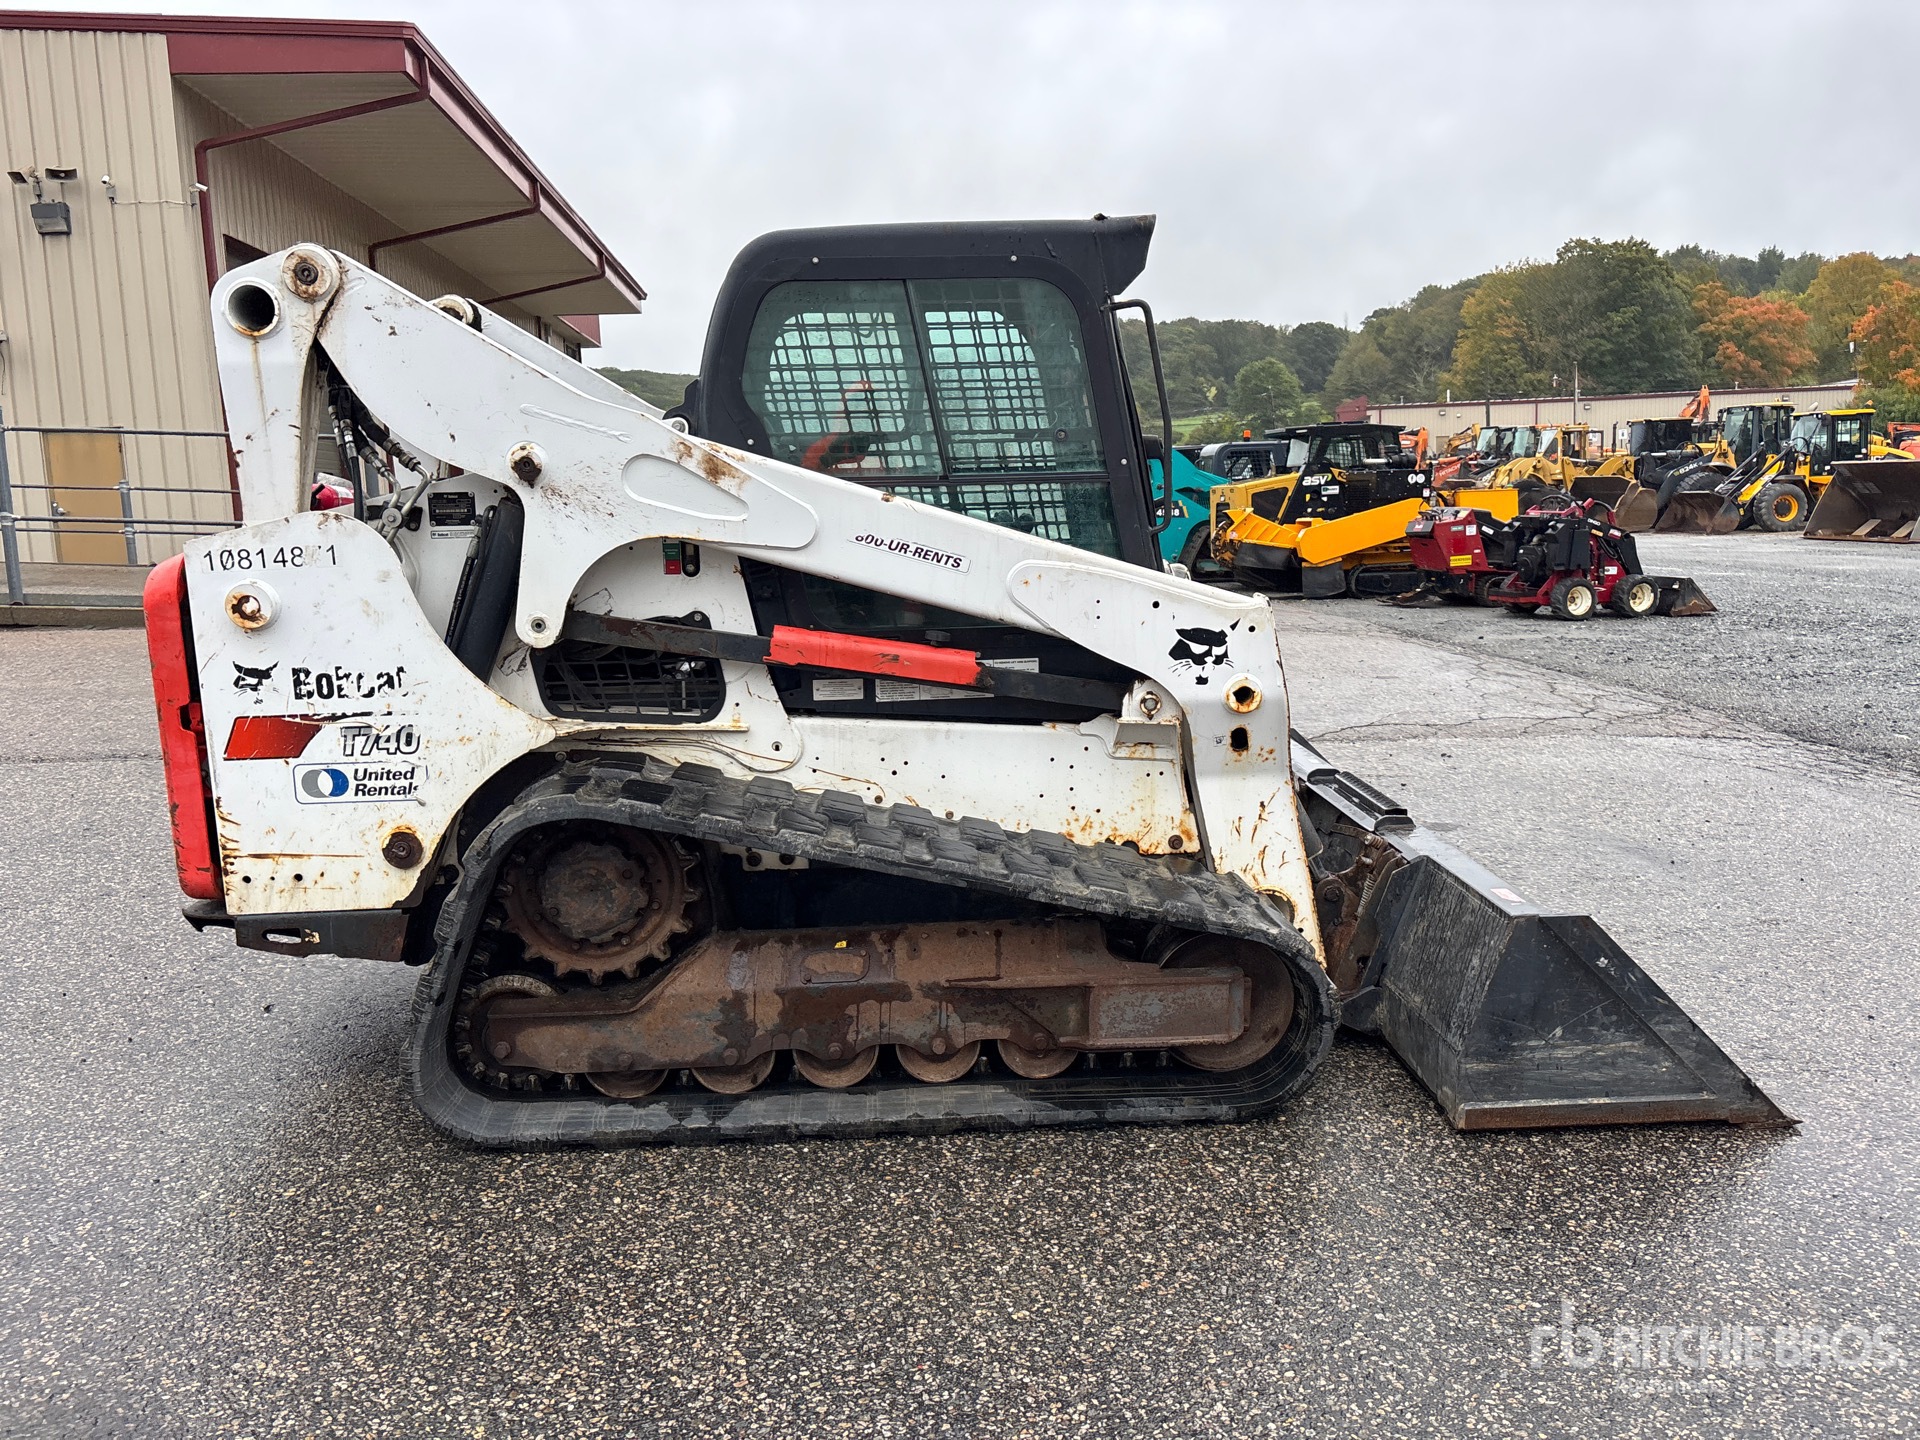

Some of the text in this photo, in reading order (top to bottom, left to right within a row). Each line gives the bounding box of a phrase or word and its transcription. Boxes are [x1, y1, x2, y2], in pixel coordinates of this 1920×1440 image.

[203, 544, 336, 571] 1081481
[340, 724, 421, 757] T740
[353, 766, 416, 783] United
